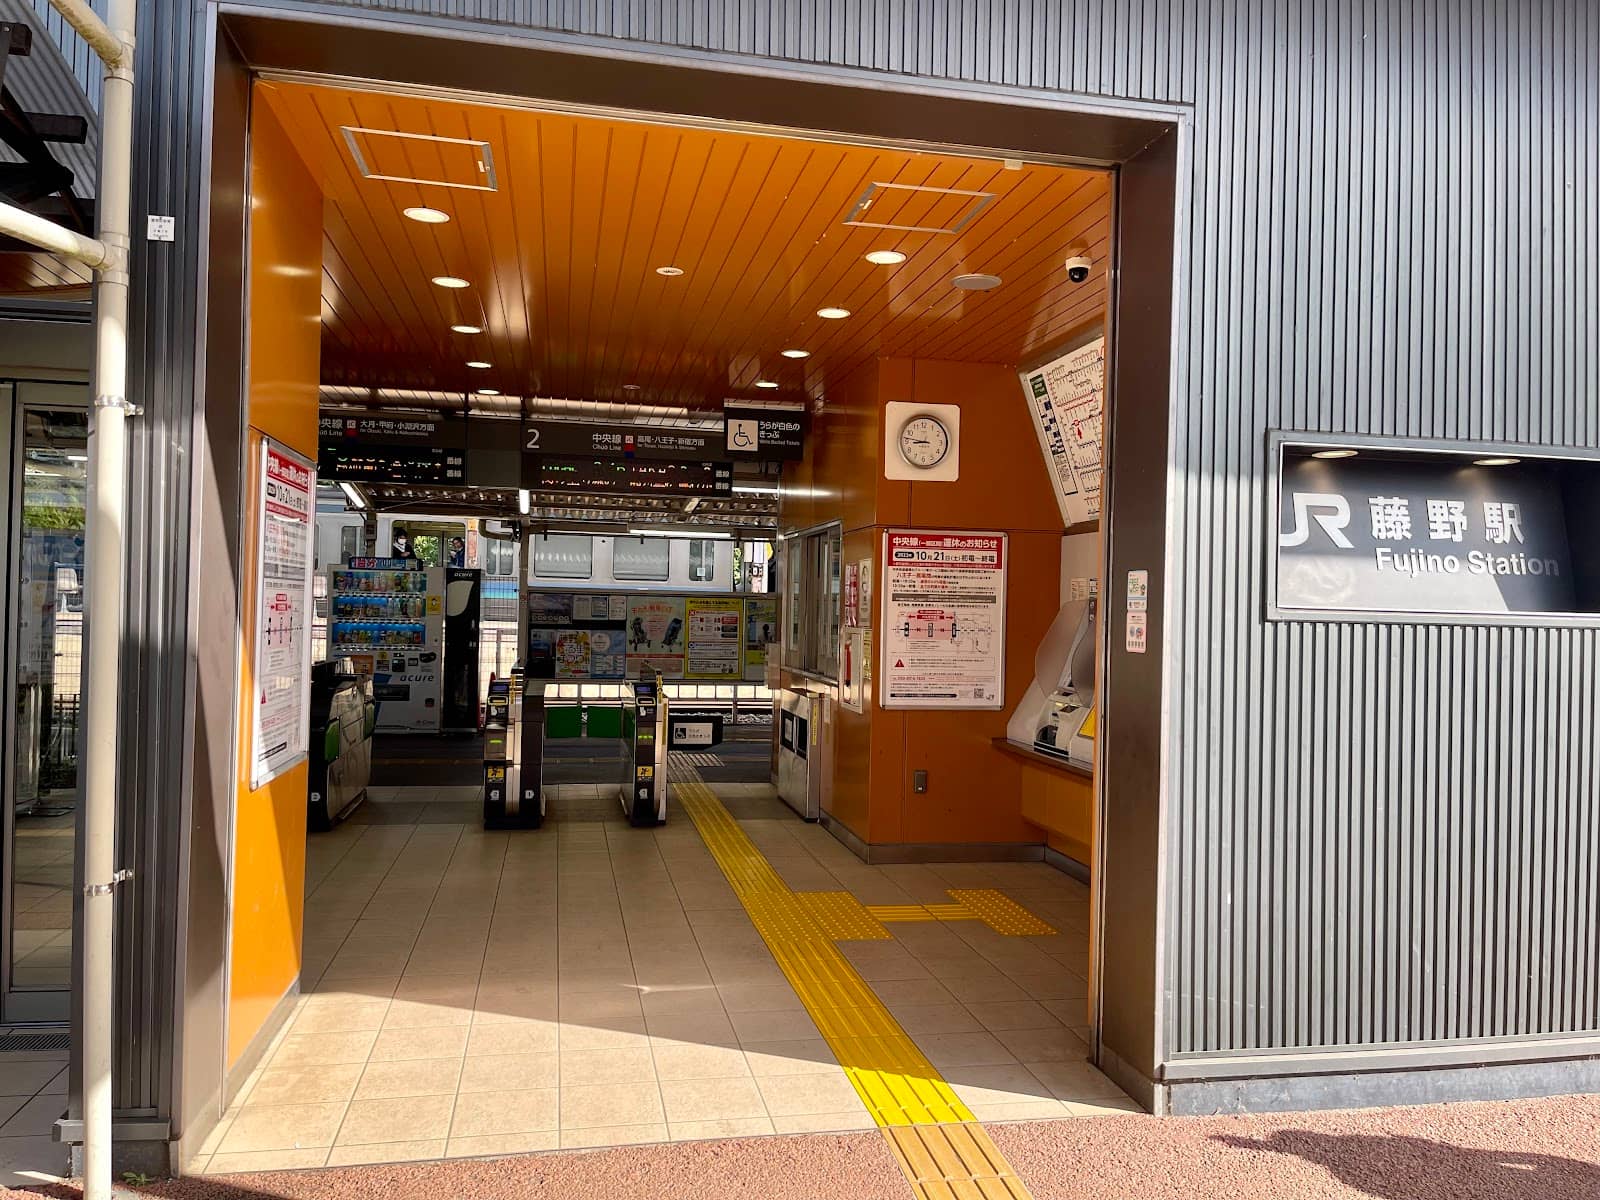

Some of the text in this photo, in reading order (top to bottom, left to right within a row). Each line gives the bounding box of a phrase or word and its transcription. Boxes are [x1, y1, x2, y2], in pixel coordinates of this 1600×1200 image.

[760, 421, 800, 431] うらが白色の
[526, 429, 541, 449] 2
[592, 433, 622, 445] 中央線
[1280, 492, 1355, 548] JR
[1368, 496, 1525, 545] 藤野駅
[1375, 547, 1560, 579] Fujino Station
[400, 674, 435, 682] acure
